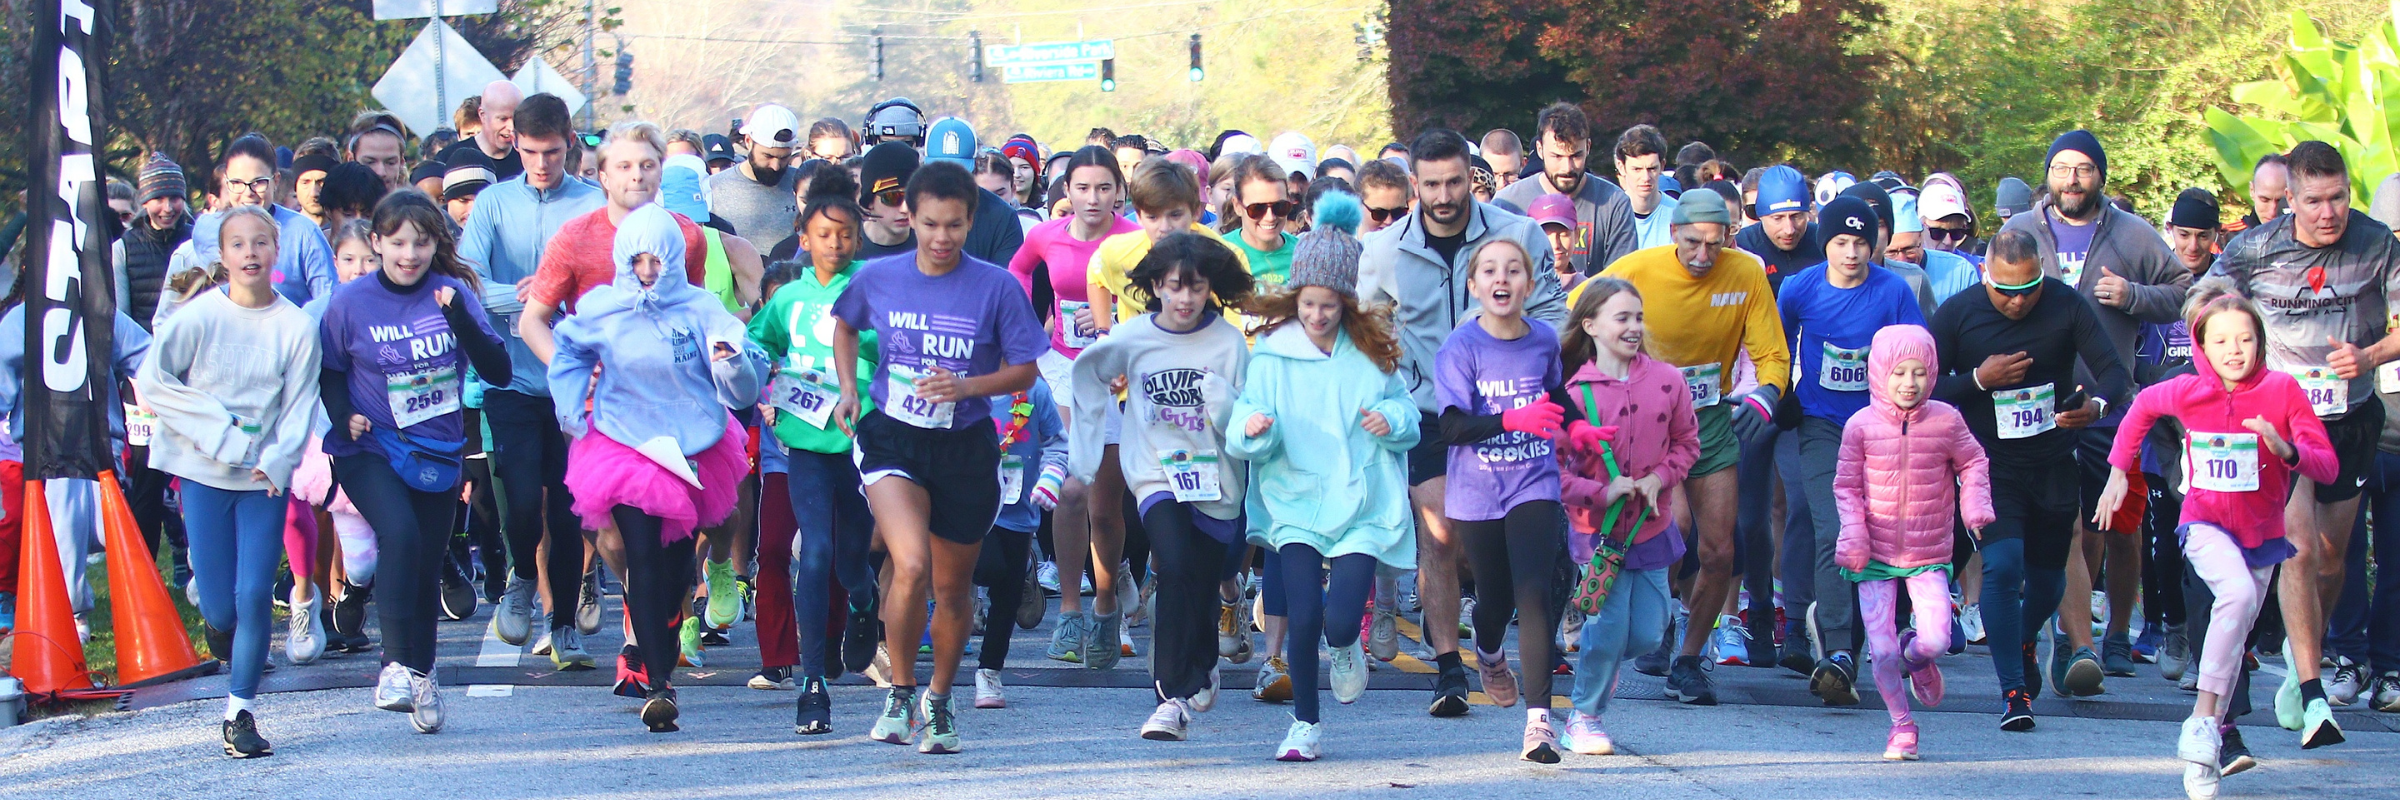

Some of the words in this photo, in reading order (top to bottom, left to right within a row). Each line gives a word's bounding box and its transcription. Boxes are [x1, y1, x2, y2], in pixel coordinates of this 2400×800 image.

[1081, 43, 1111, 57] Park
[1710, 291, 1748, 307] NAVY
[2271, 298, 2332, 309] RUNNING
[889, 311, 930, 331] WILL
[369, 325, 414, 343] WILL
[410, 332, 458, 361] RUN
[923, 333, 975, 360] RUN
[921, 357, 937, 366] FOR
[1830, 366, 1865, 383] 606
[1476, 380, 1518, 398] WILL
[1688, 383, 1708, 402] 63
[406, 390, 443, 414] 259
[788, 387, 825, 414] 267
[1160, 407, 1205, 432] GUTS
[2012, 408, 2043, 428] 794
[1477, 440, 1551, 463] COOKIES
[2206, 459, 2238, 479] 170
[1174, 471, 1201, 491] 167
